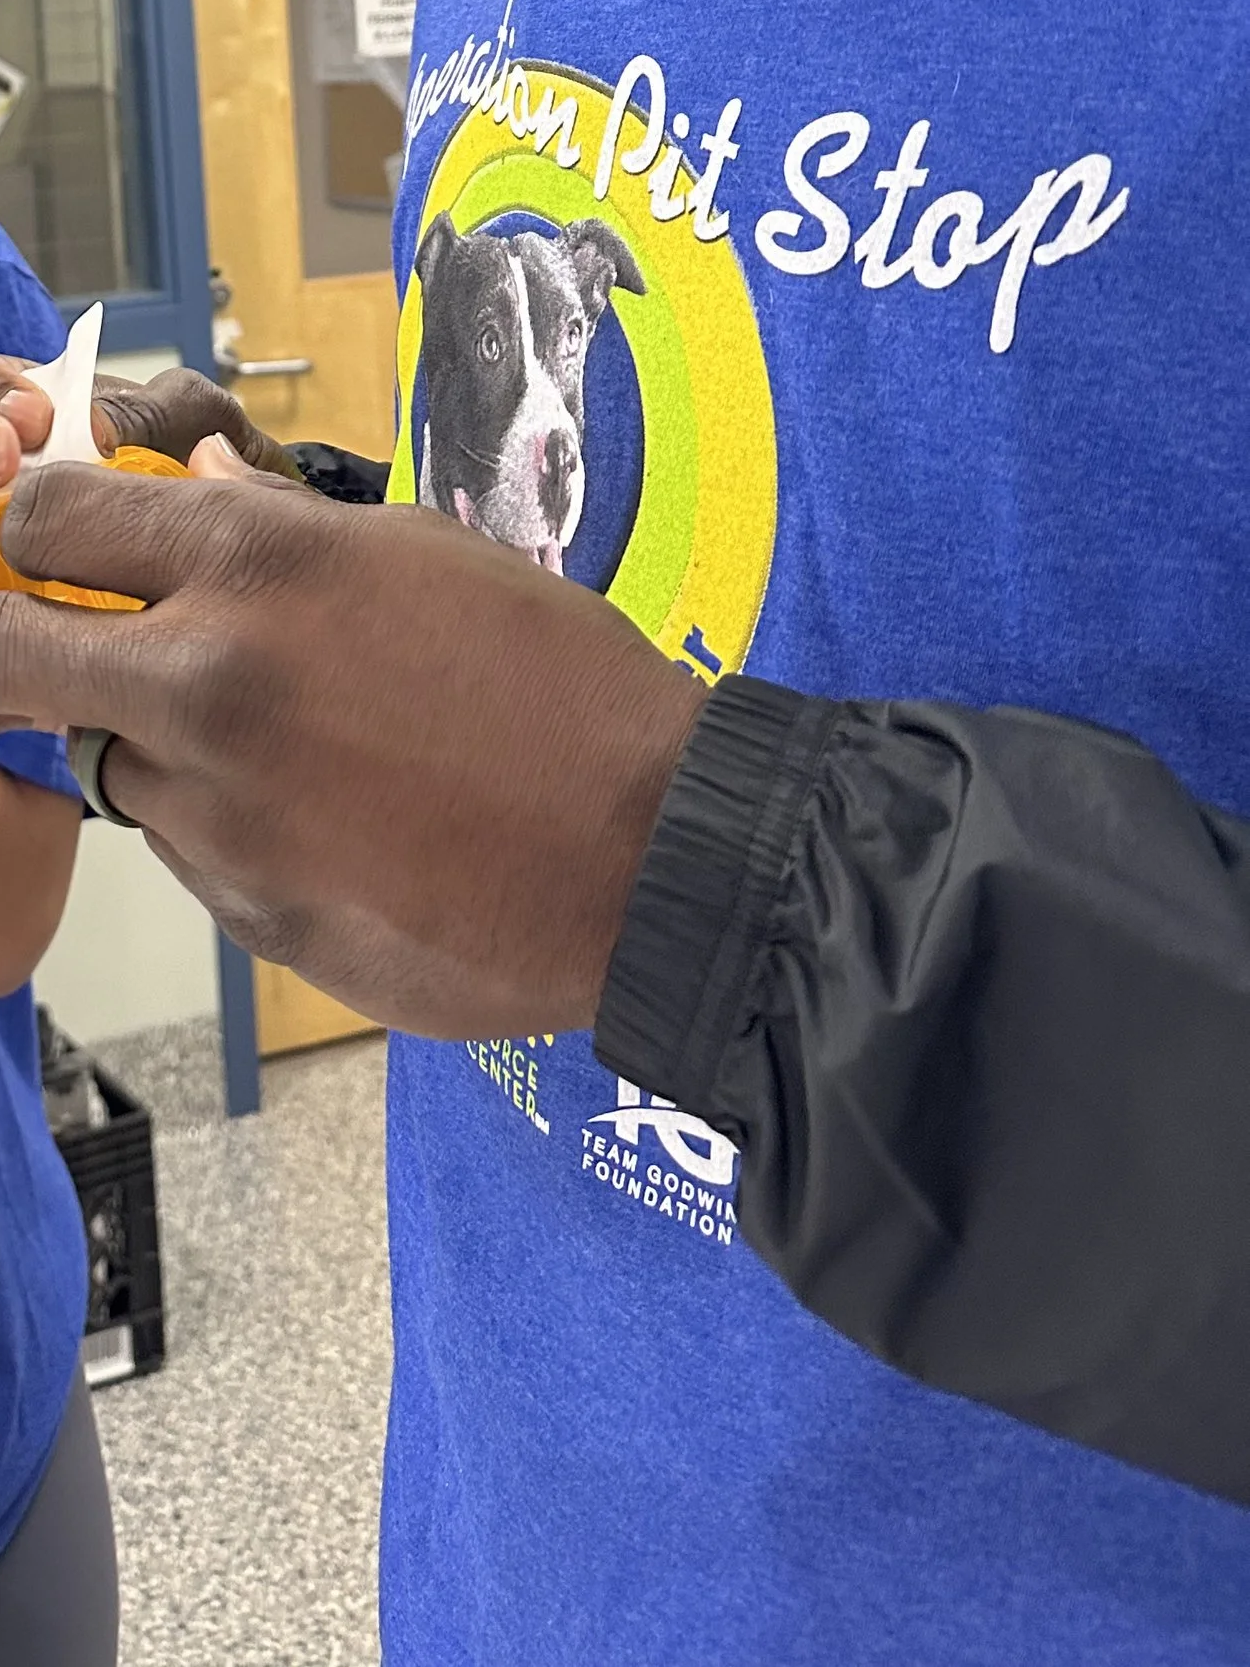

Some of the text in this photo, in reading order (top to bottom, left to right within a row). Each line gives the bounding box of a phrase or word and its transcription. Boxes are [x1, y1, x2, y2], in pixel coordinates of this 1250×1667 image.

[595, 54, 743, 241] Pit
[755, 110, 1131, 353] Stop
[581, 1128, 738, 1224] TEAM GODWIN
[581, 1155, 733, 1246] FOUNDATION
